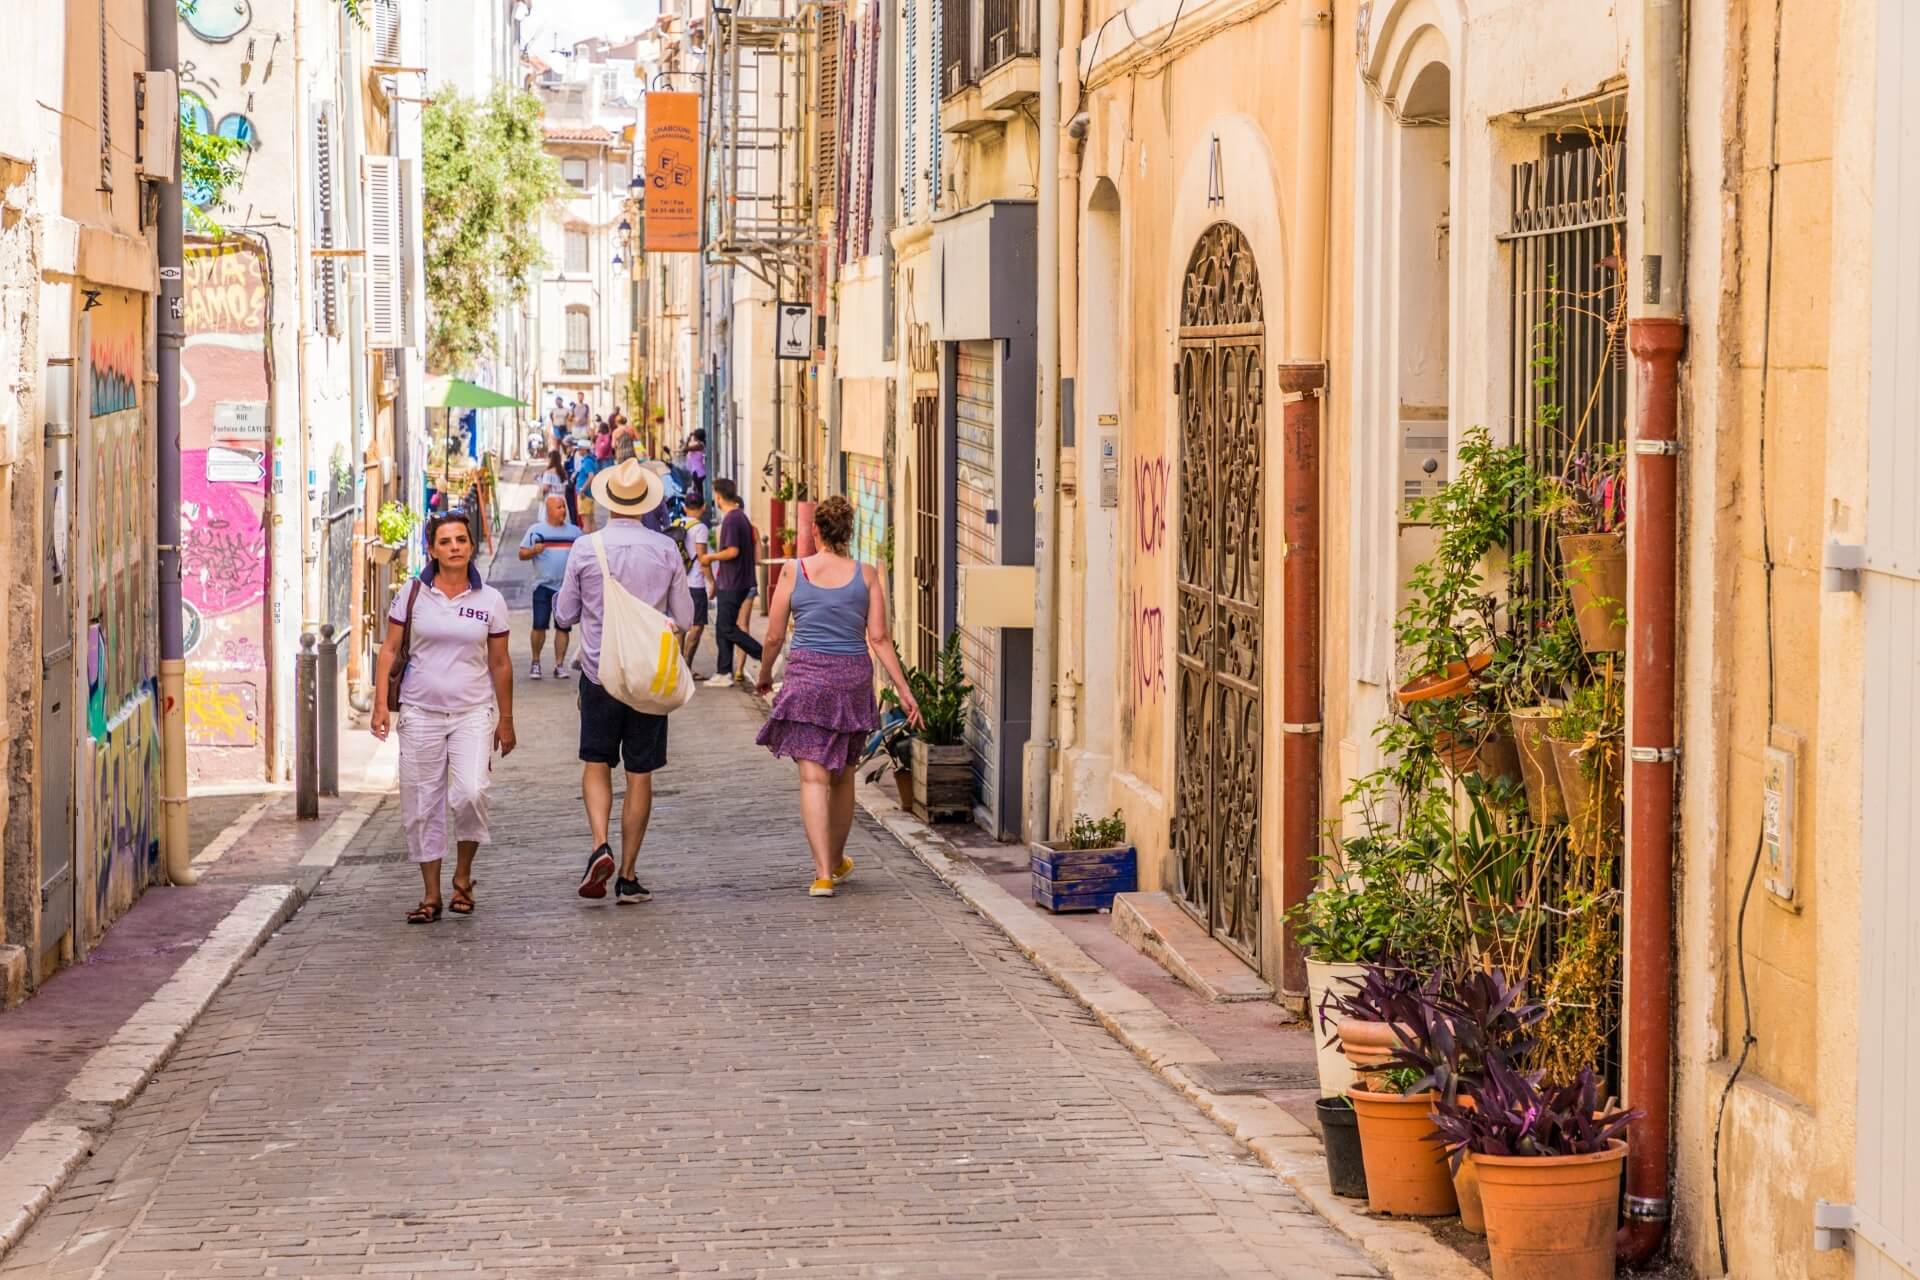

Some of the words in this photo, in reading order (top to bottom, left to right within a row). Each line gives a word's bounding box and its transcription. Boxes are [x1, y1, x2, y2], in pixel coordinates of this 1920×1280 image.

[662, 158, 672, 168] F
[654, 176, 665, 188] C
[675, 173, 683, 185] E
[236, 413, 248, 421] RUE
